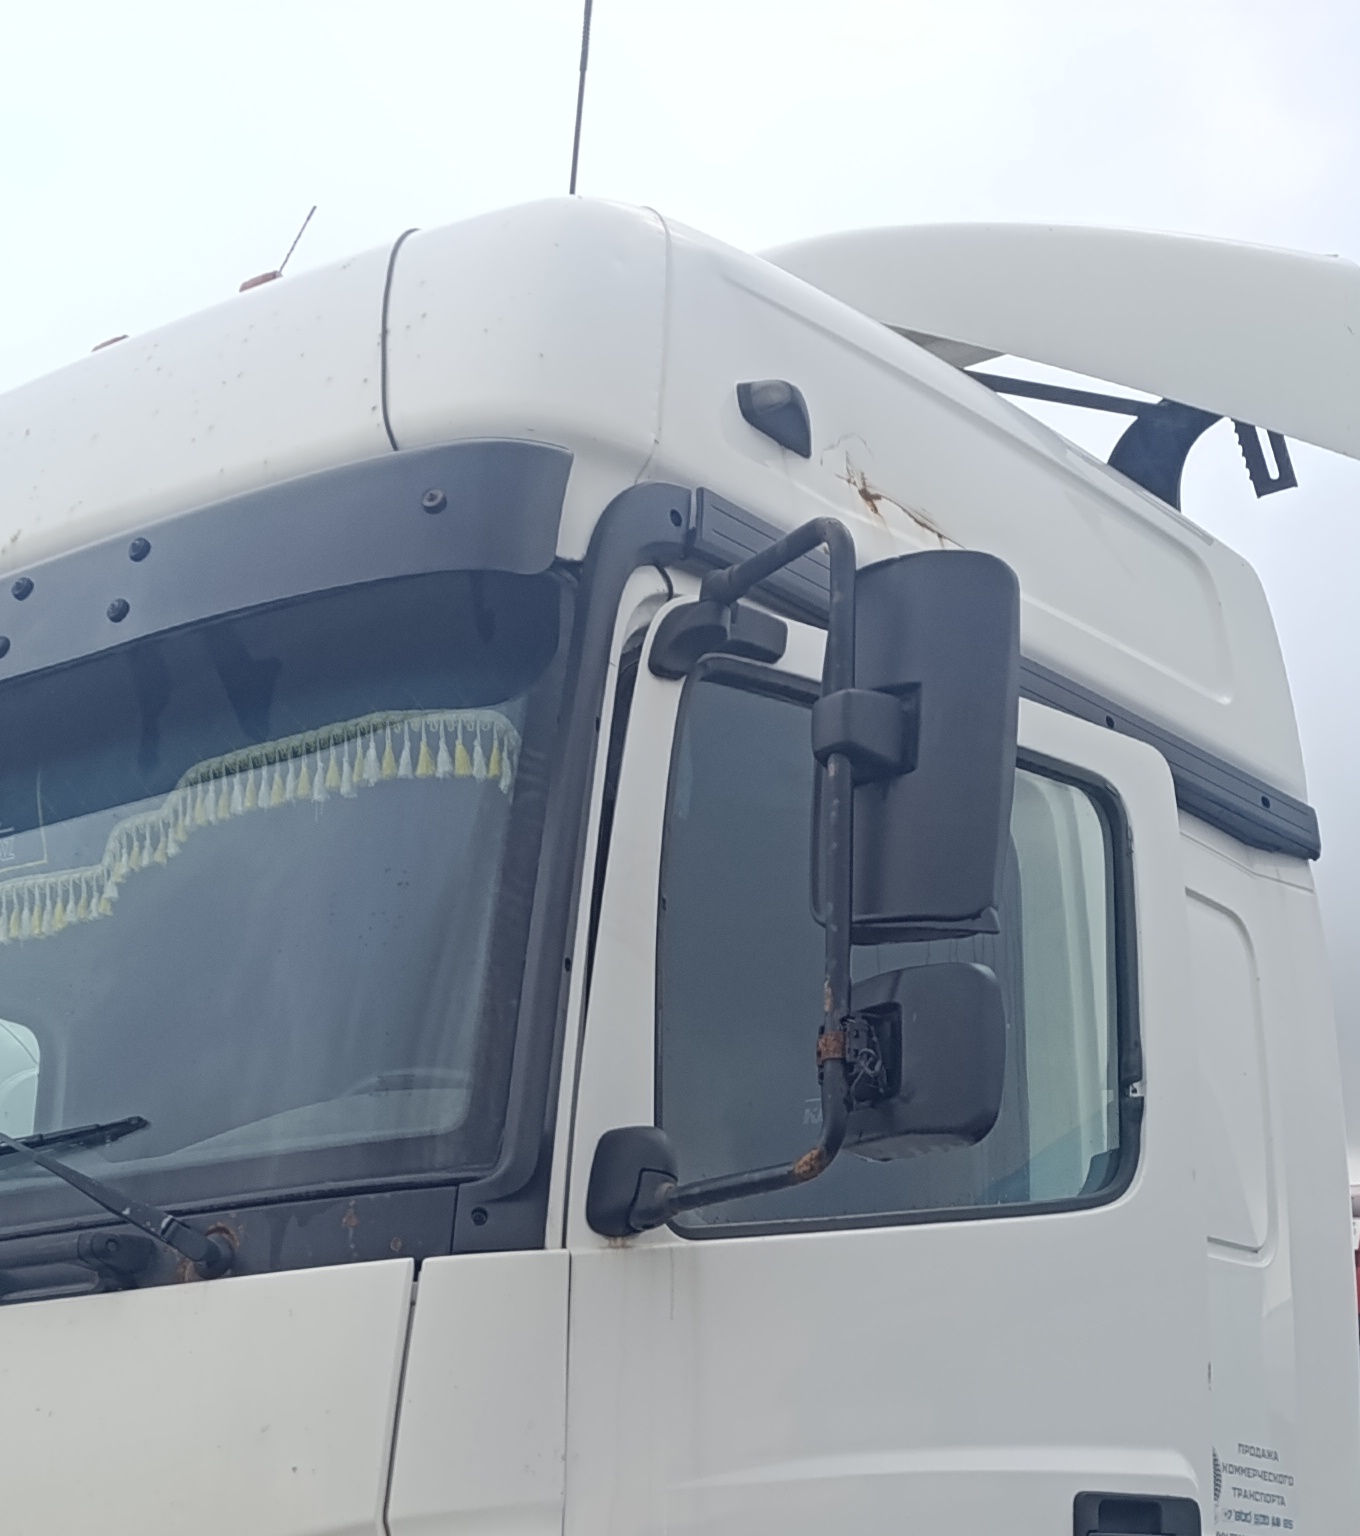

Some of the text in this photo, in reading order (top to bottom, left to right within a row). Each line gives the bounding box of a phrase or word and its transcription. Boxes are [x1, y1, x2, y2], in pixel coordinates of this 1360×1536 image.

[1237, 1443, 1279, 1461] ПРОДАЖА
[1222, 1462, 1294, 1487] КОММЕРЧЕСКОГО
[1232, 1487, 1286, 1506] ТРАНСПОРТА
